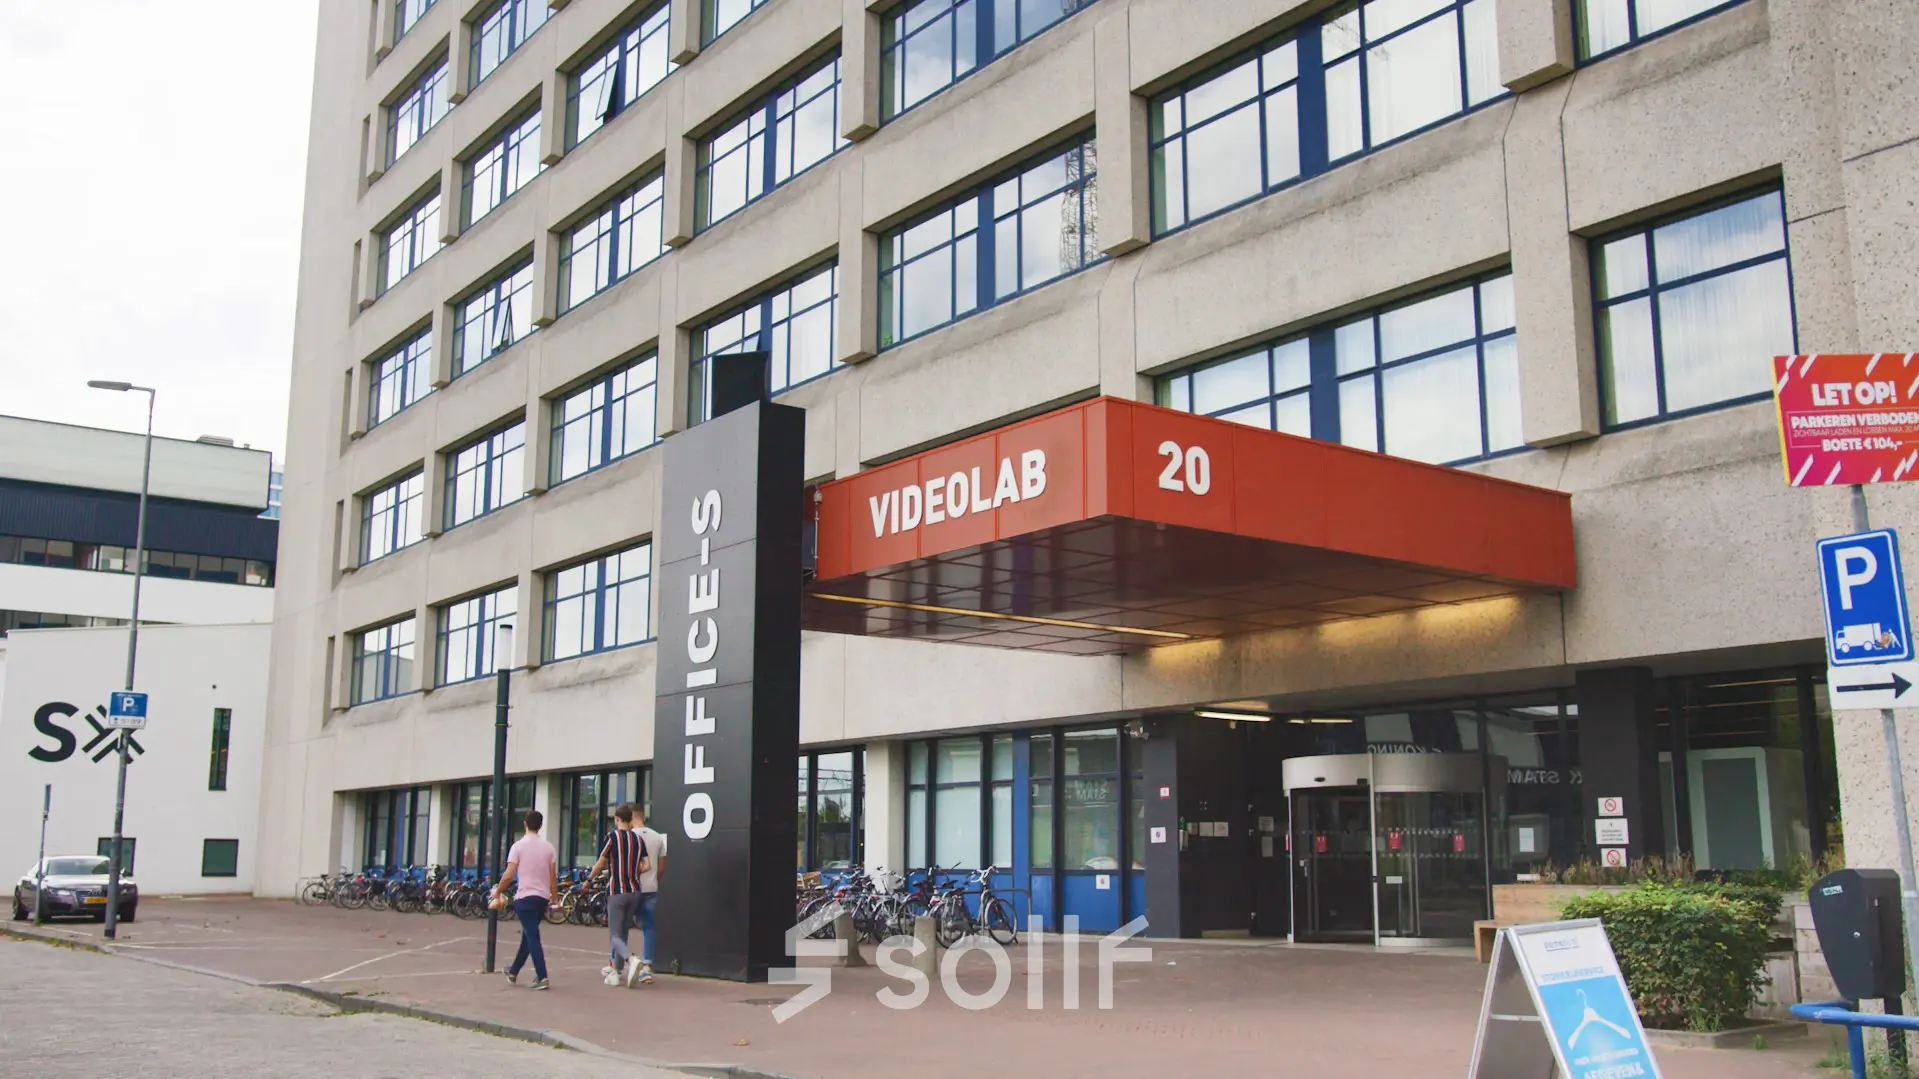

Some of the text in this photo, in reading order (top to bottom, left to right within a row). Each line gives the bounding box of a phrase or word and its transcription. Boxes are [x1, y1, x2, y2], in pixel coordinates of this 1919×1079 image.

[1811, 381, 1897, 406] LET OP!
[1791, 414, 1855, 429] PARKEREN
[1822, 437, 1862, 452] BOETE
[1157, 440, 1211, 495] 20
[869, 448, 1047, 538] VIDEOLAB
[1835, 546, 1877, 610] P
[683, 489, 723, 840] OFFICE-S
[122, 697, 135, 712] P
